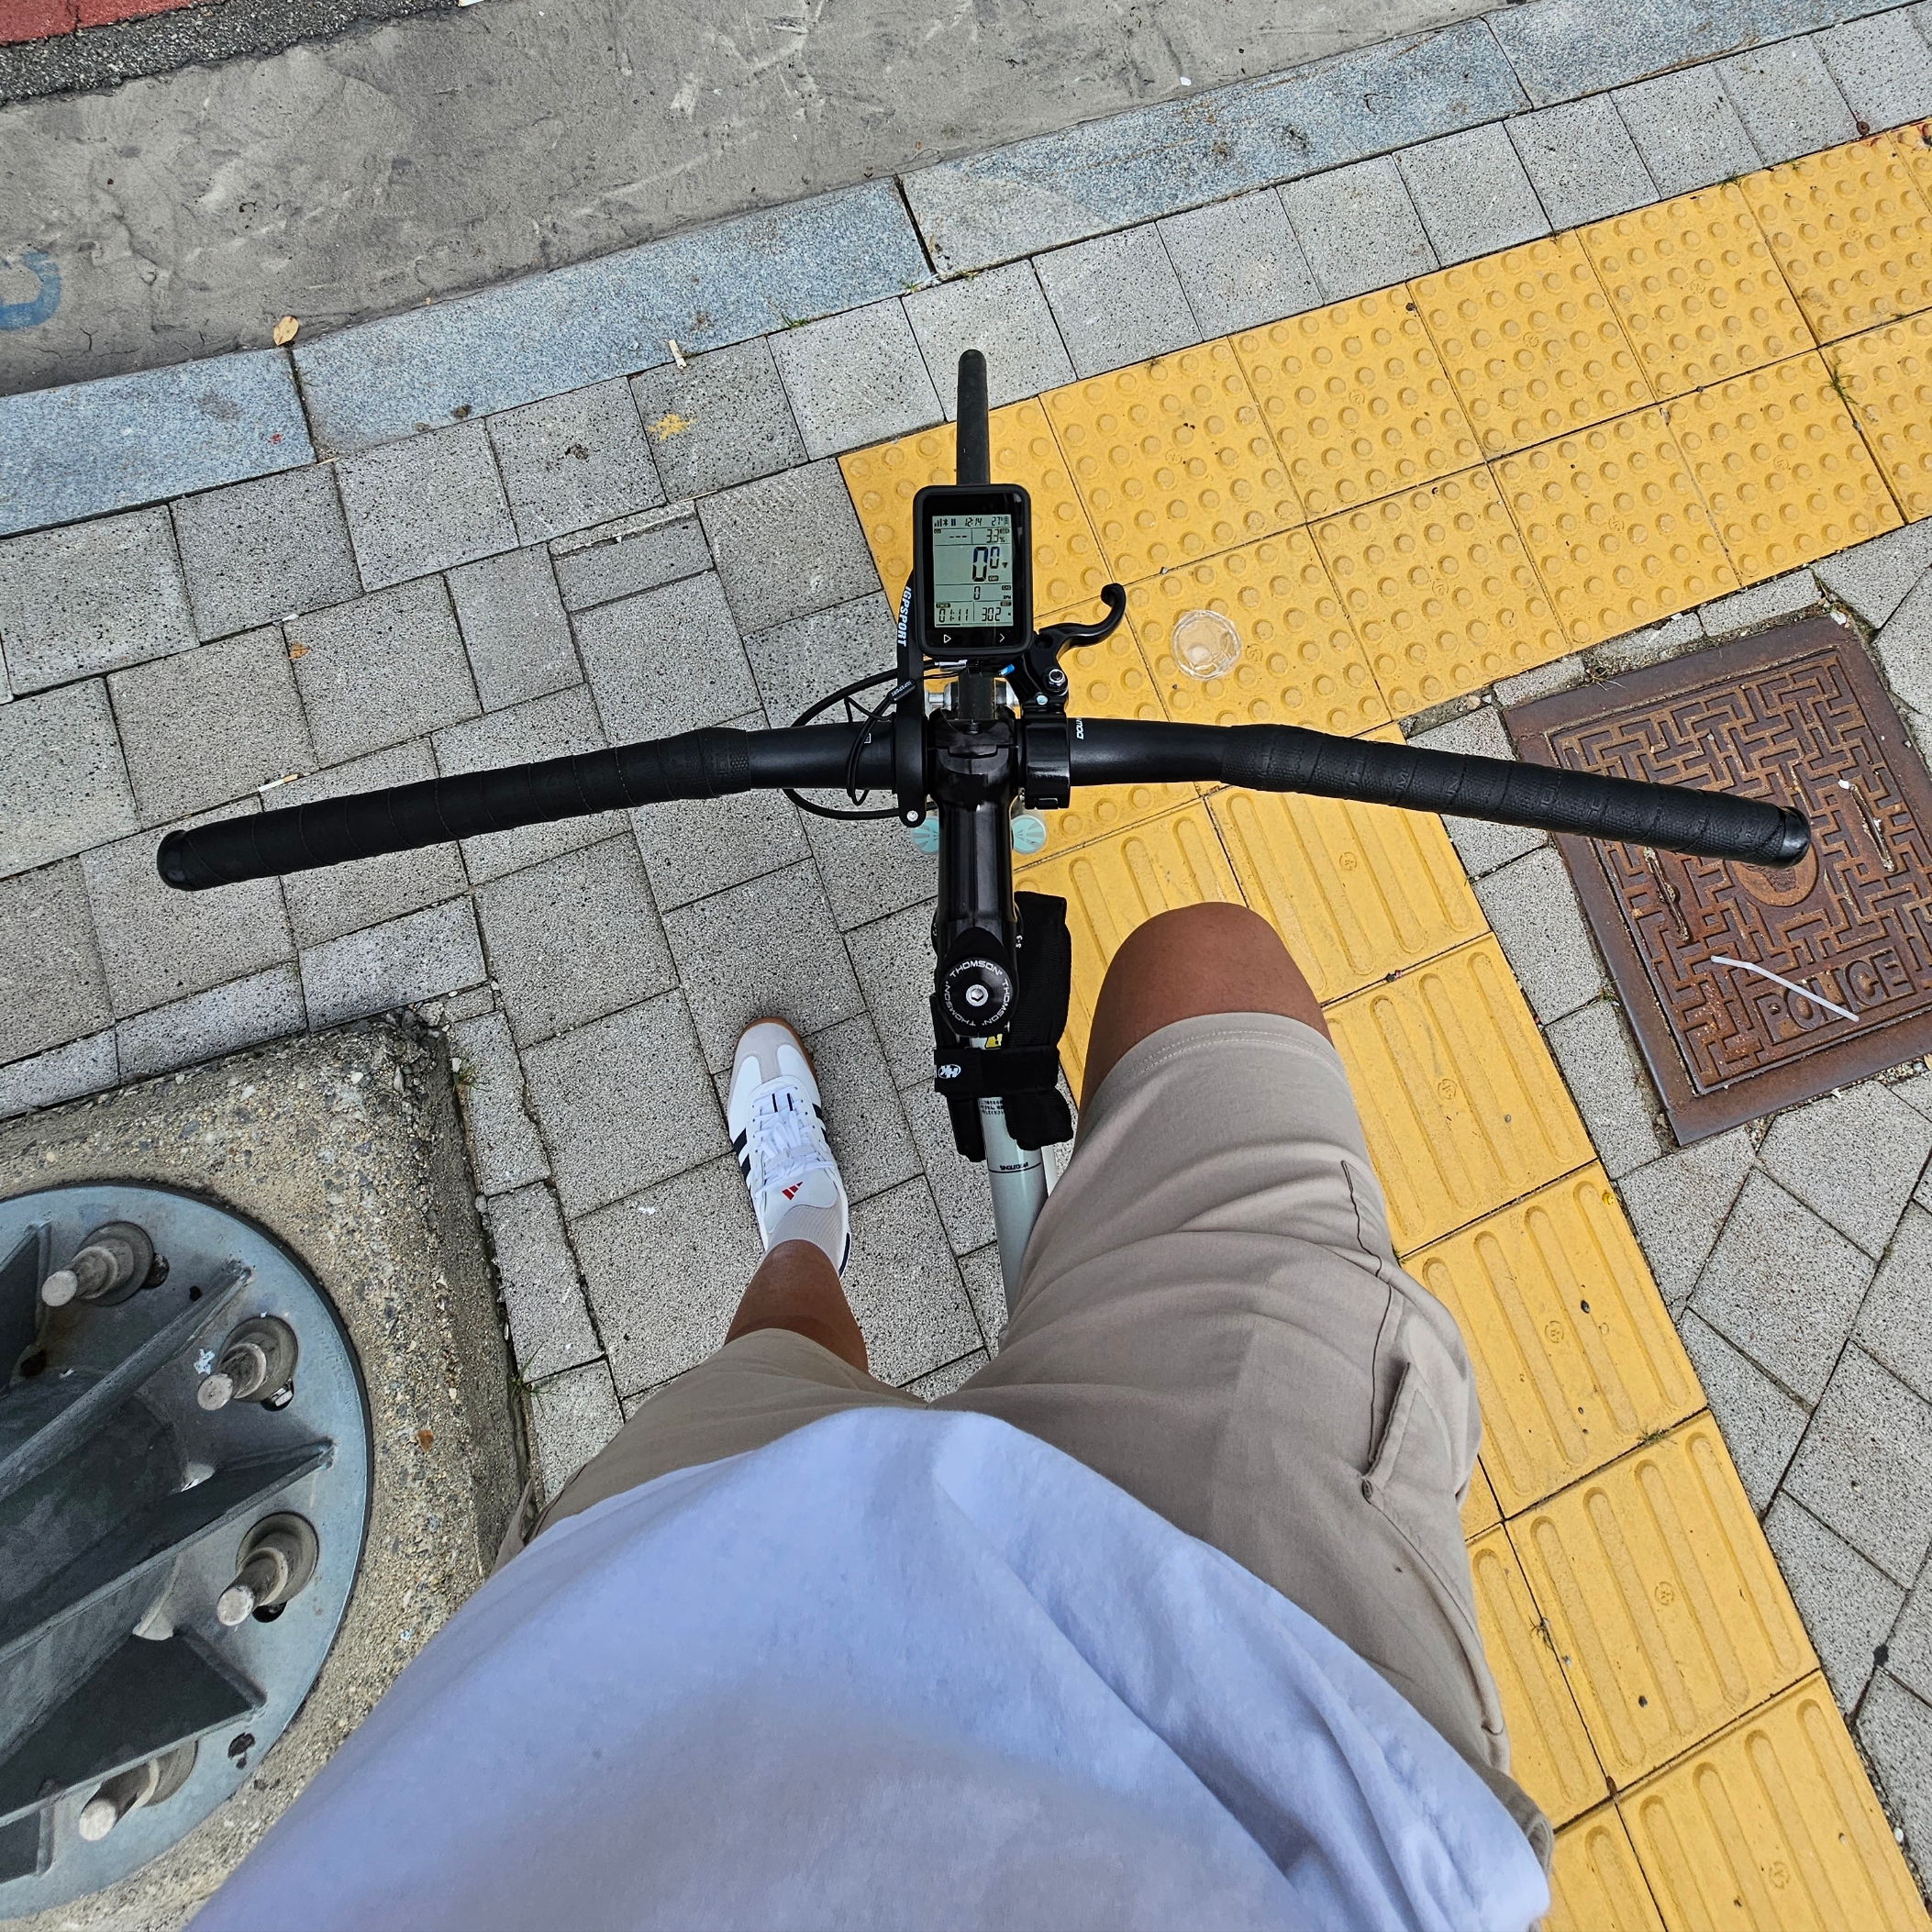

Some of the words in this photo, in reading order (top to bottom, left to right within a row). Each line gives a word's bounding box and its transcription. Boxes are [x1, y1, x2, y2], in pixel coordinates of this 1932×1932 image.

[964, 516, 983, 527] 12:14
[973, 585, 981, 600] 0
[938, 608, 969, 623] 01:11
[982, 607, 1002, 621] 302
[1753, 947, 1916, 1045] POLICE
